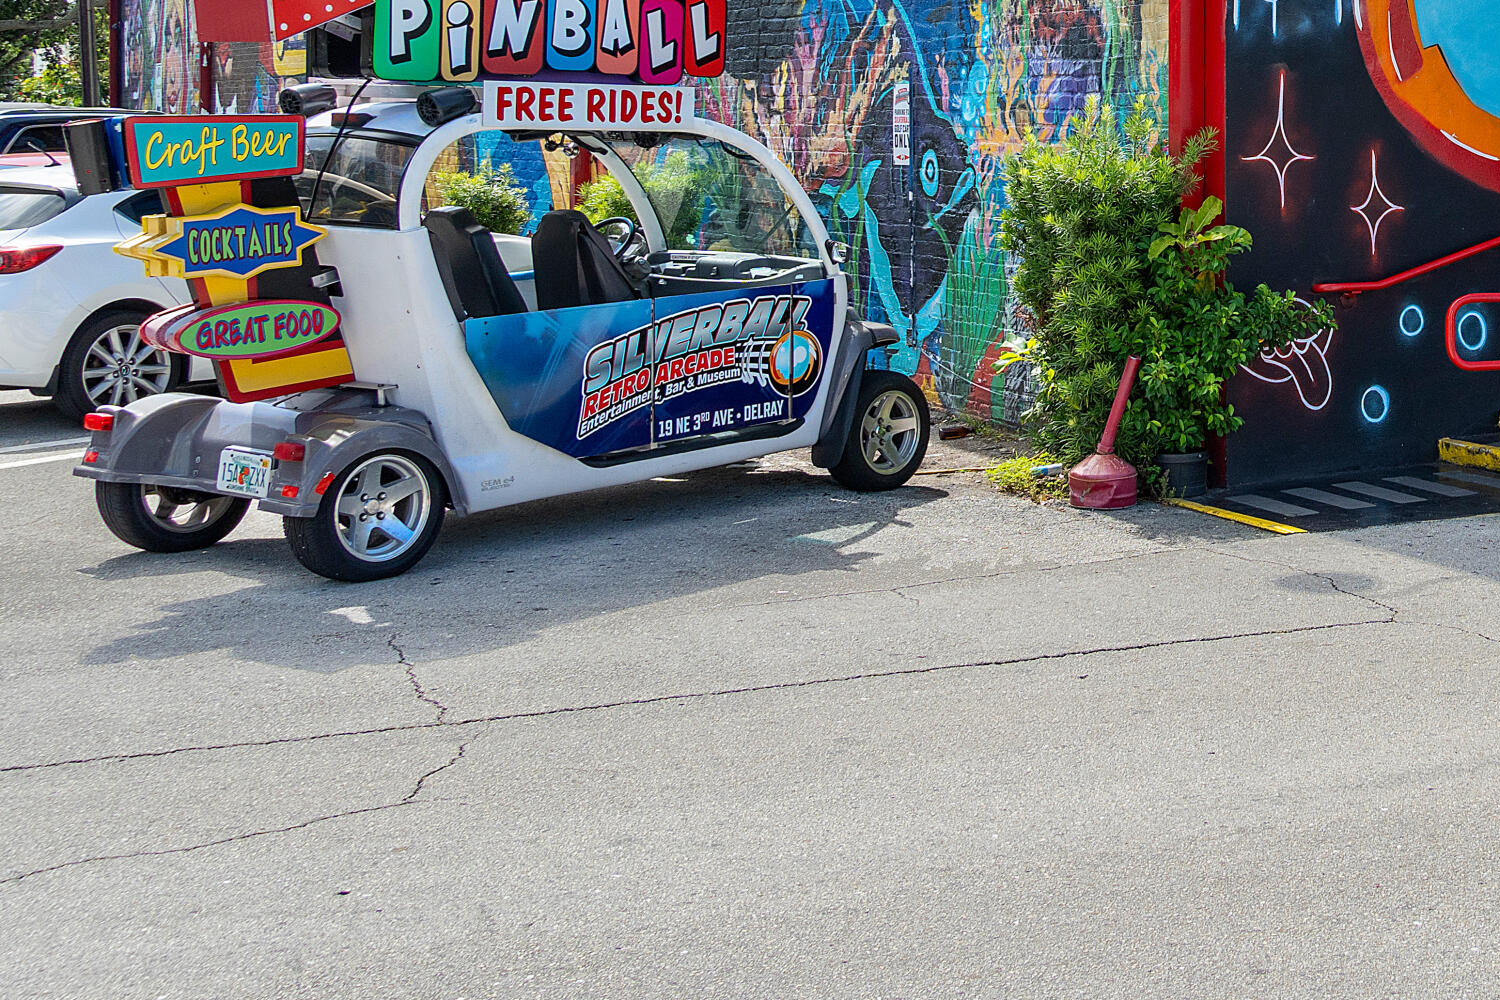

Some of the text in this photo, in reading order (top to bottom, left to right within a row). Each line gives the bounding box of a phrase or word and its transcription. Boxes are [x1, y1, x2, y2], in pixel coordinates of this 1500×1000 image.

[497, 86, 683, 123] FREE RIDES!
[145, 124, 293, 175] Craft Beer
[187, 220, 294, 265] COCKTAILS
[196, 308, 325, 350] GREAT FOOD
[586, 297, 810, 393] SILVERBALL
[579, 367, 741, 437] Entertainment, Bar & Museum
[583, 347, 736, 419] RETRO ARCADE
[658, 420, 673, 438] 19
[675, 418, 691, 436] NE
[712, 408, 735, 428] AVE
[743, 400, 785, 422] DELRAY
